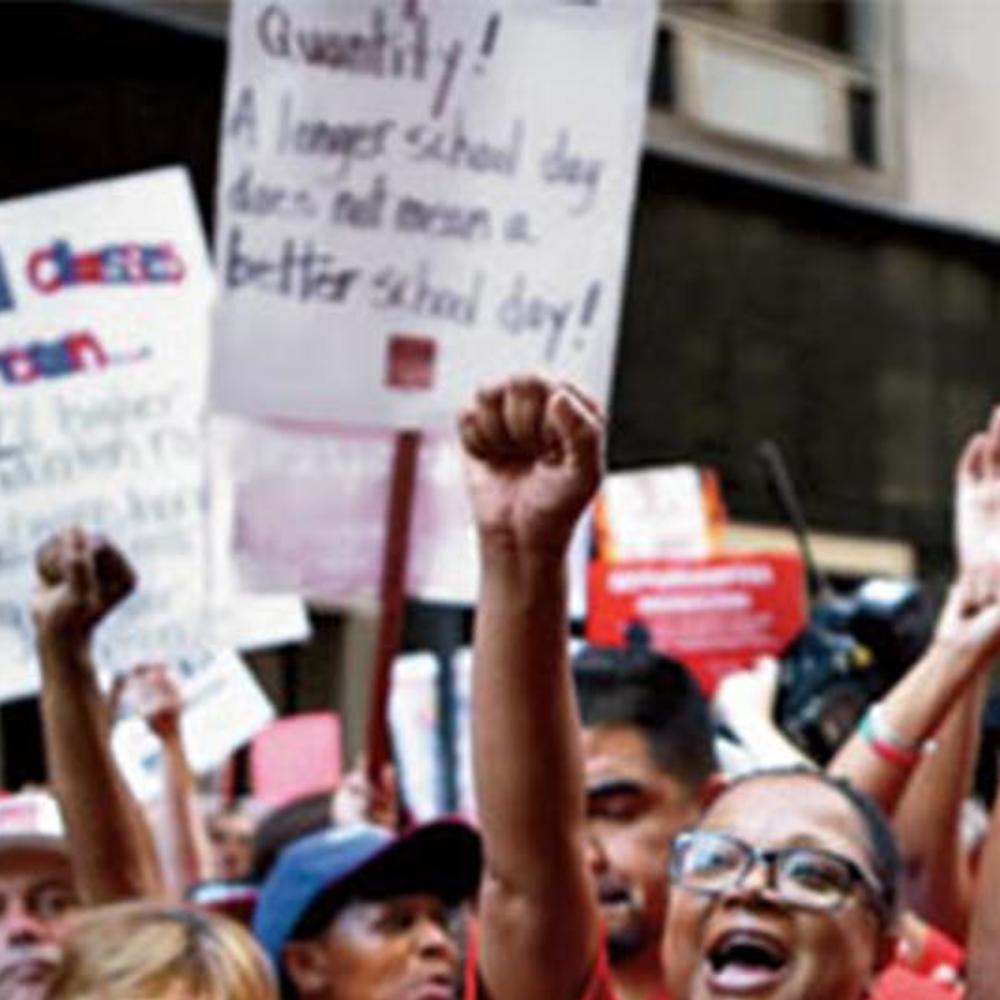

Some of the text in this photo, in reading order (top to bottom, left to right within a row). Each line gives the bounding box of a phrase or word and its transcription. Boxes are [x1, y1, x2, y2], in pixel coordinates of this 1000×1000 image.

[229, 84, 257, 148] A
[504, 210, 538, 243] a
[226, 225, 356, 303] better
